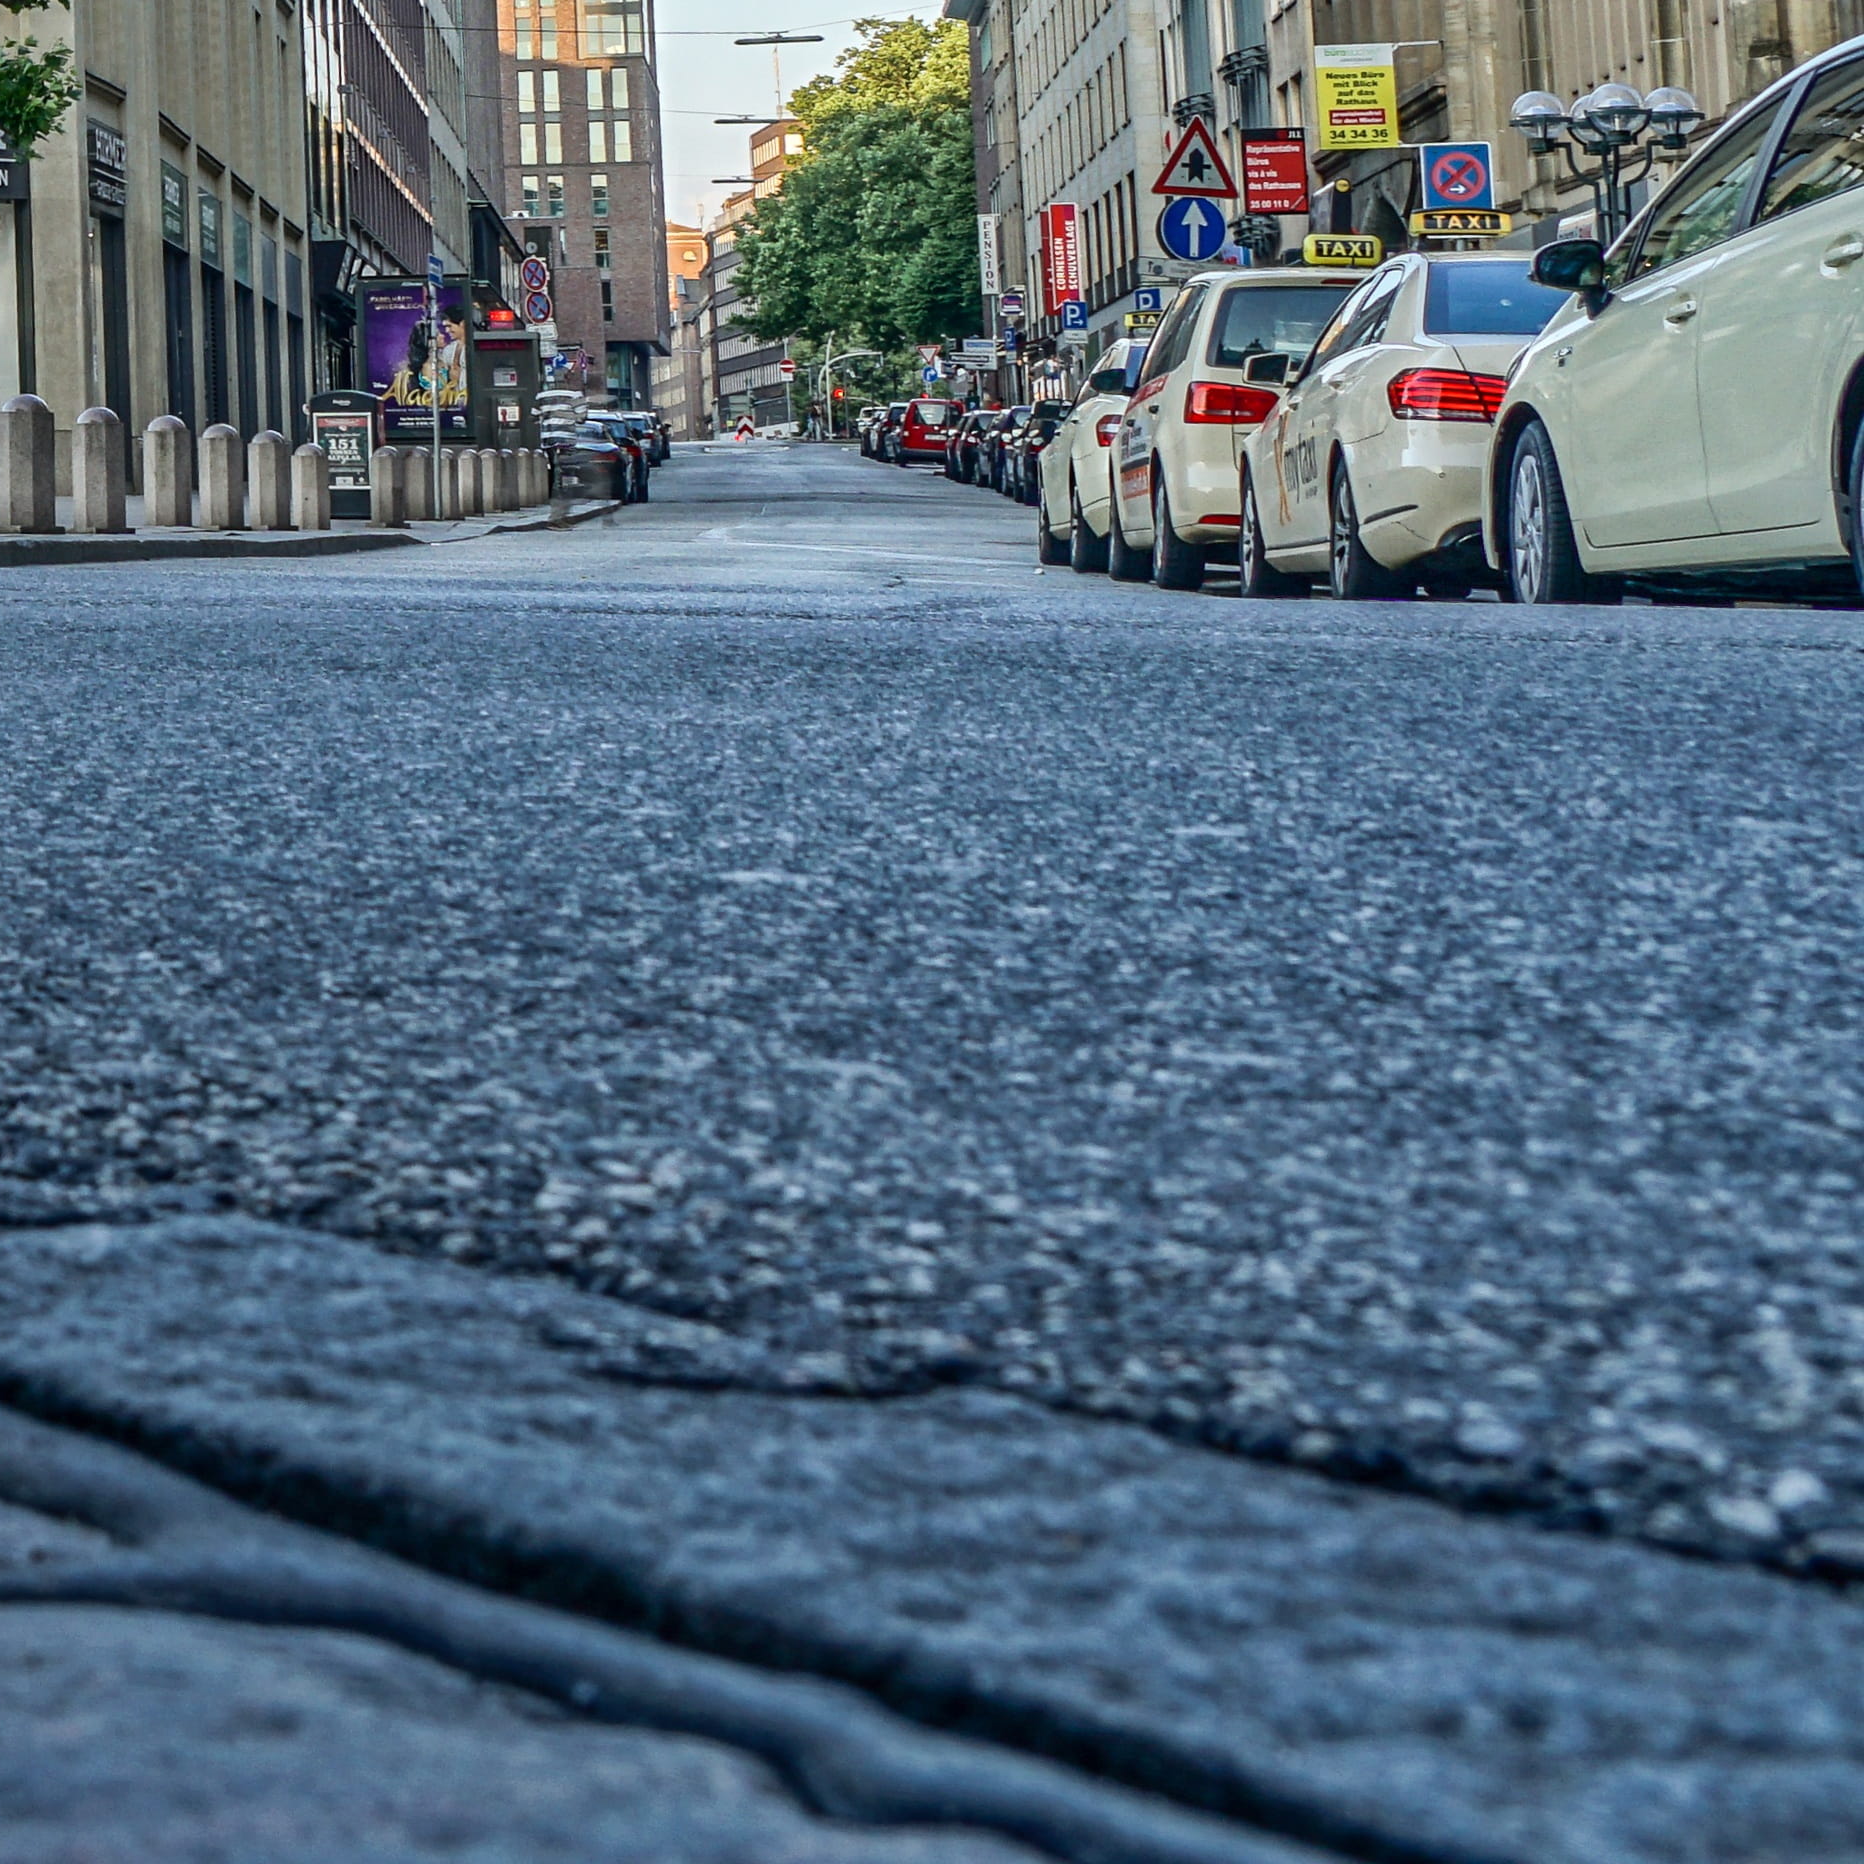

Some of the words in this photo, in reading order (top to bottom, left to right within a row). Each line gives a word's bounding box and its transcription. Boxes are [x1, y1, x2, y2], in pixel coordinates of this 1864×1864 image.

[1333, 80, 1350, 88] mit
[1353, 79, 1378, 87] Blick
[1337, 89, 1354, 97] auf
[1329, 130, 1346, 139] 34
[1350, 129, 1367, 139] 34
[1371, 128, 1388, 138] 36
[1431, 215, 1491, 229] TAXI
[982, 220, 995, 289] PENSION
[1319, 241, 1372, 256] TAXI
[1054, 237, 1066, 291] CORNELSEN
[1066, 305, 1080, 326] P
[328, 438, 359, 450] 151
